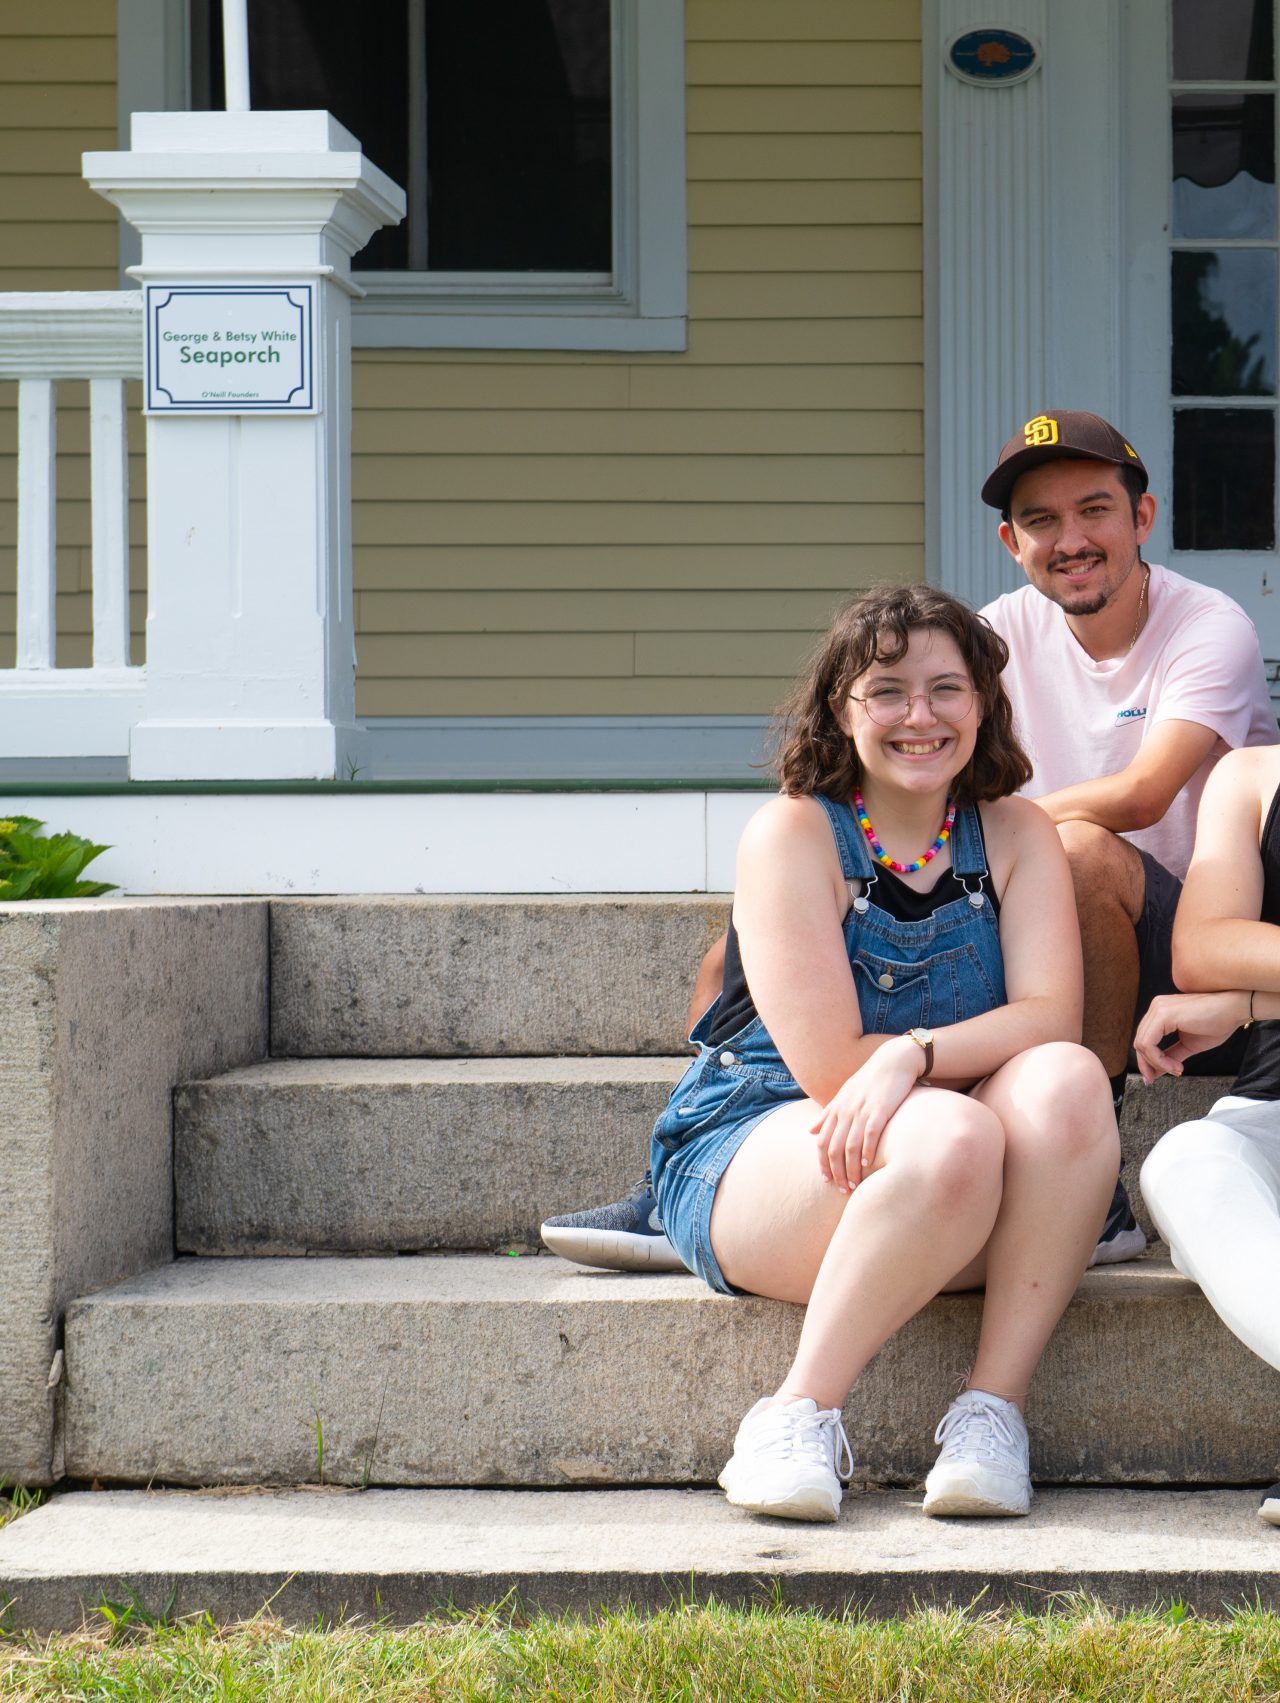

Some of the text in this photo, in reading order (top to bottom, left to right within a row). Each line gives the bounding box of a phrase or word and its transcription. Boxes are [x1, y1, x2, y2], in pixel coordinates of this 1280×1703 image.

[163, 330, 297, 344] George & Betsy White
[180, 345, 281, 368] Seaporch
[1024, 415, 1059, 446] SD
